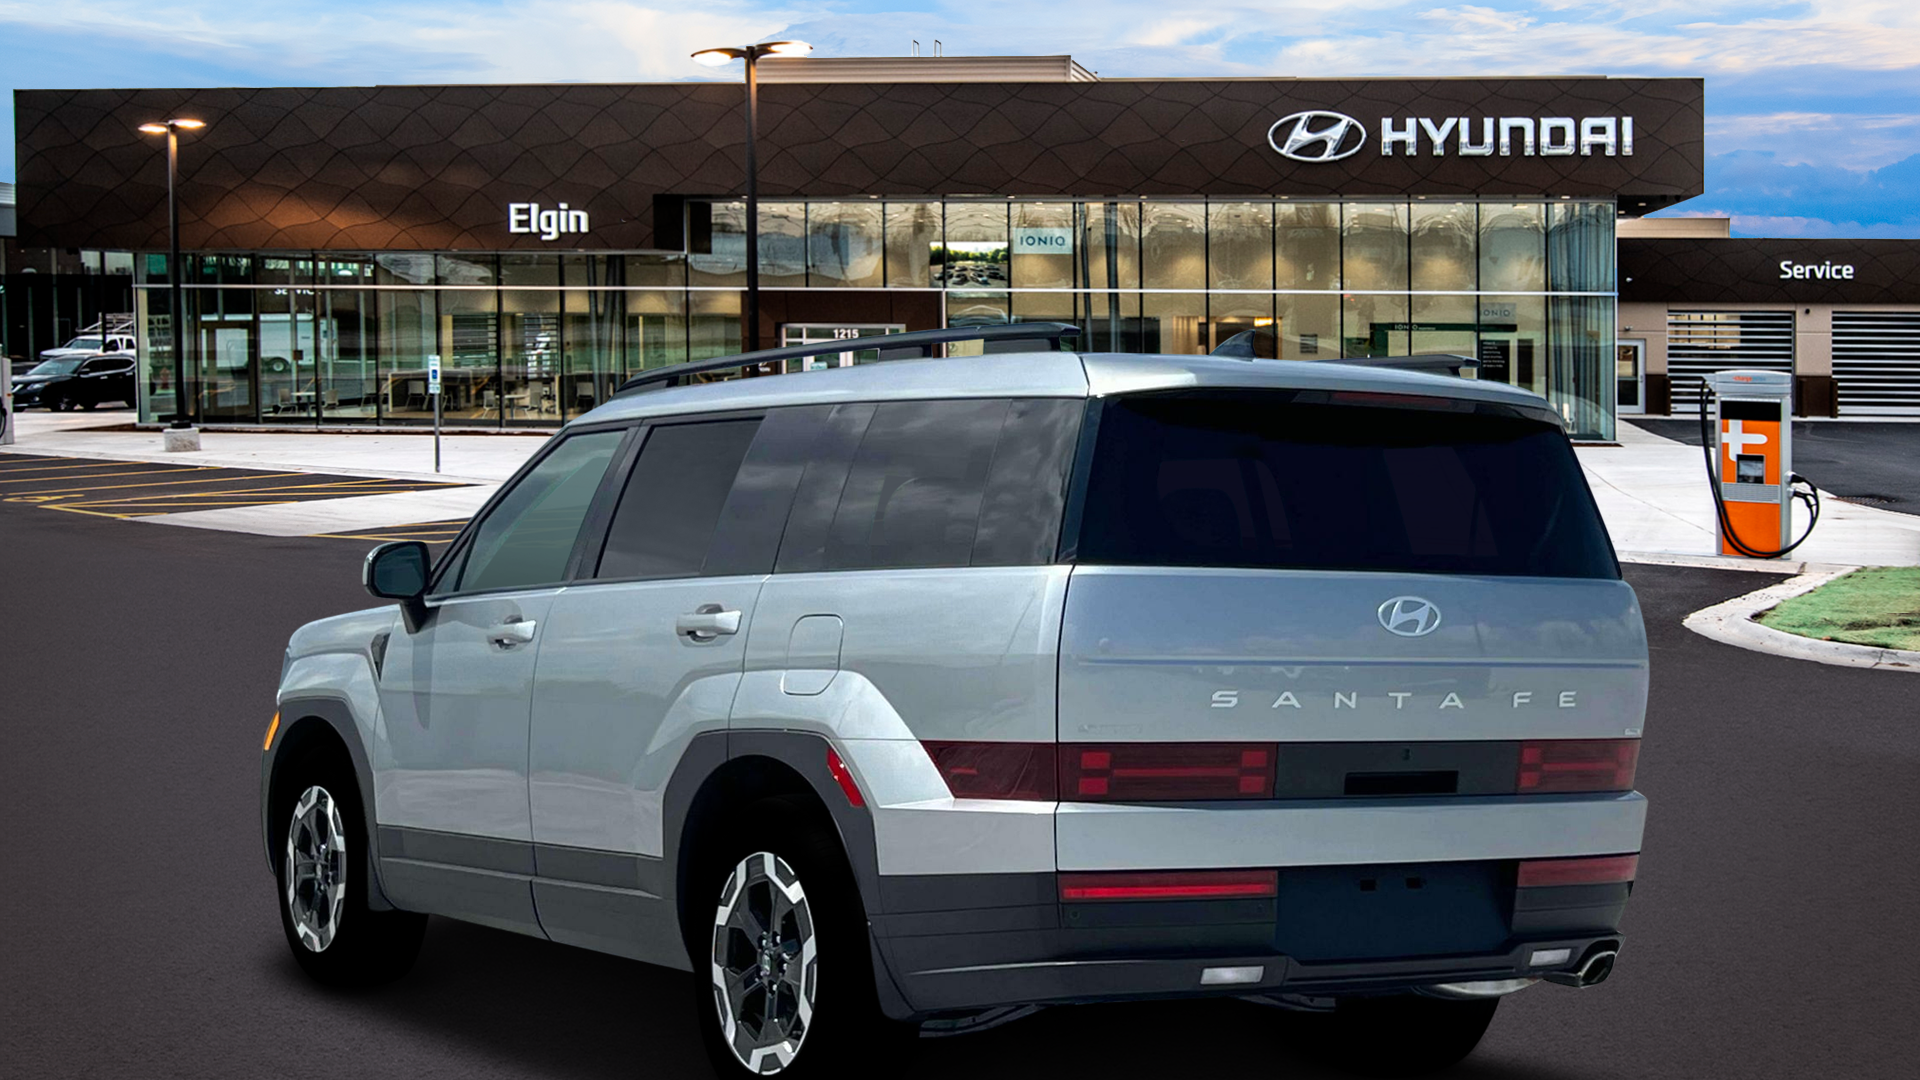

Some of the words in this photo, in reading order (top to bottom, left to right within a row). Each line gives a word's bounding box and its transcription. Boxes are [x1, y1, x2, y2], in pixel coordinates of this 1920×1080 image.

[1381, 117, 1634, 157] HYUNDAI
[508, 202, 590, 241] Elgin
[1020, 235, 1066, 247] IONIQ
[1779, 260, 1855, 280] Service
[833, 328, 859, 339] 1215
[1211, 690, 1465, 710] SANTA
[1512, 690, 1578, 708] FE
